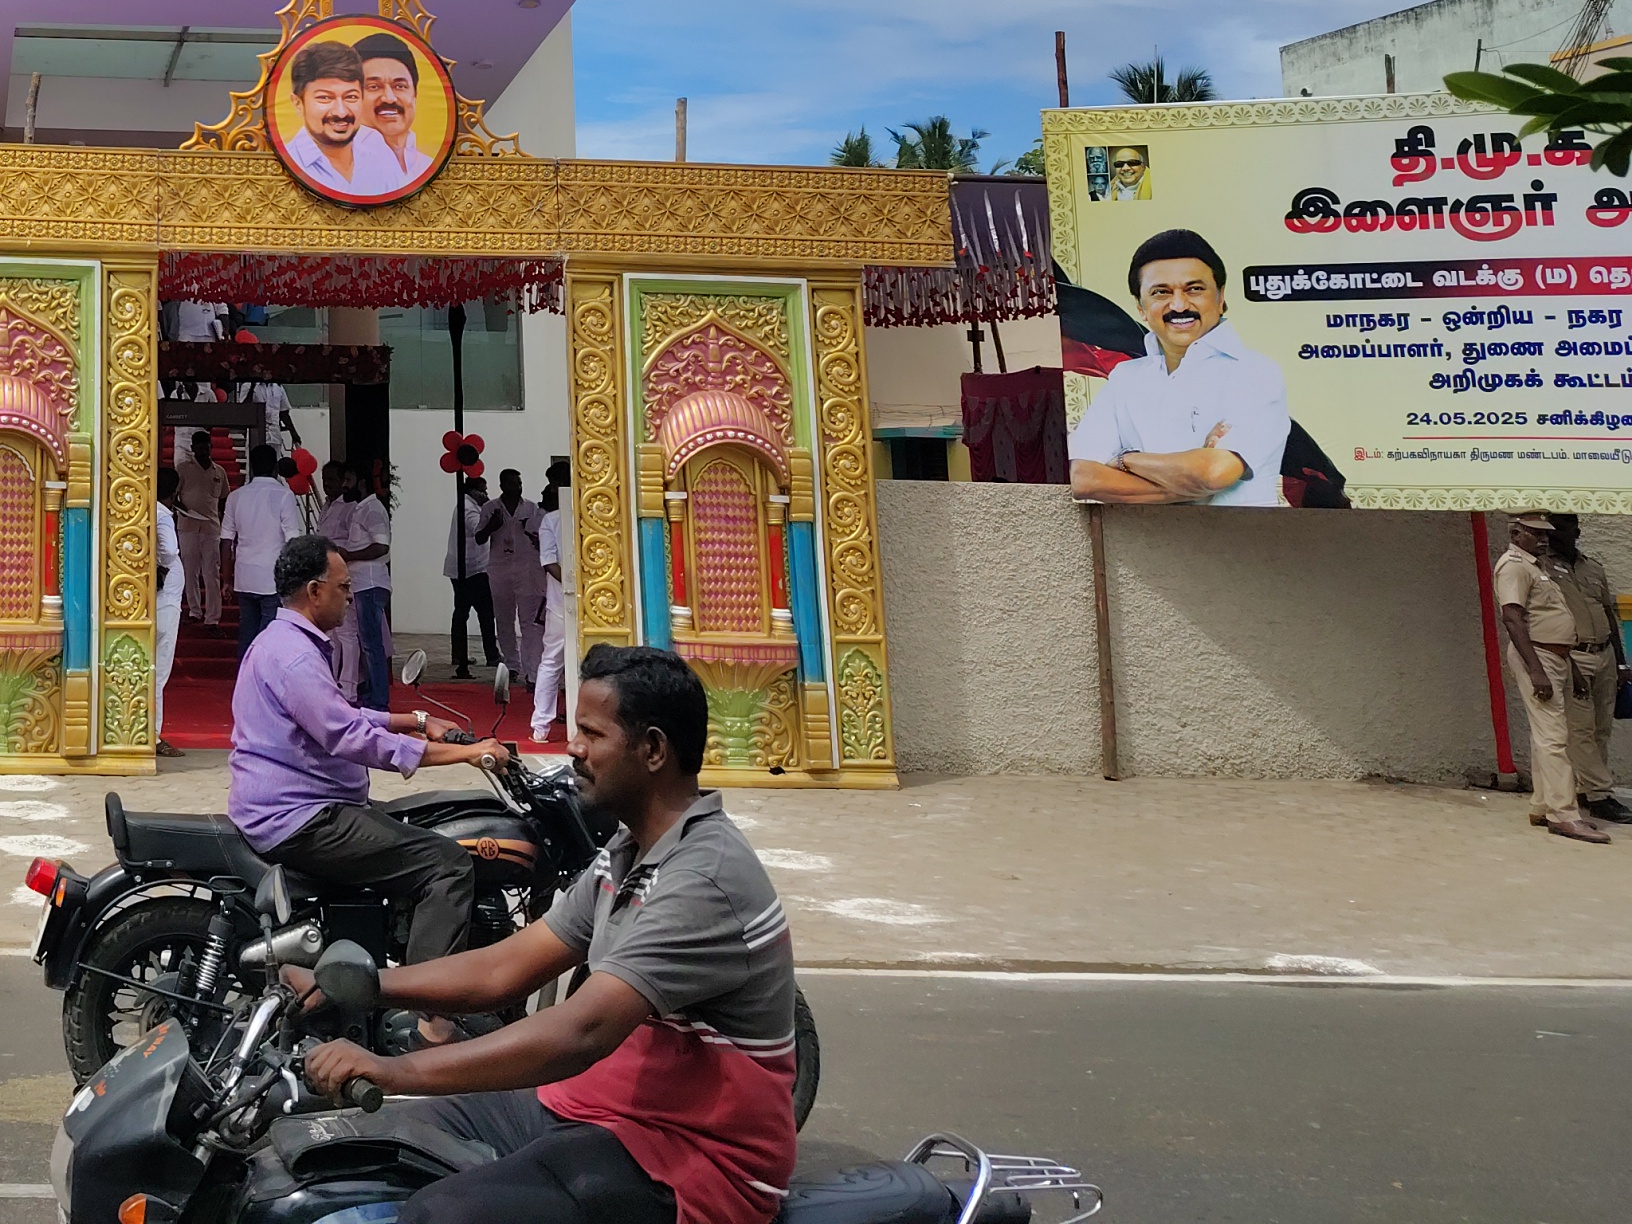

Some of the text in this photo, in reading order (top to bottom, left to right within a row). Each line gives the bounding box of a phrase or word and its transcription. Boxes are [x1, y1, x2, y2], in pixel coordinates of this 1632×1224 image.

[1390, 125, 1594, 187] தி.மு.க
[1284, 179, 1632, 242] இளைஞர் அ
[1250, 268, 1423, 299] புதுக்கோட்டை
[1432, 264, 1525, 290] வடக்கு
[1535, 264, 1578, 290] (ம)
[1325, 311, 1411, 333] மாநகர
[1442, 304, 1534, 332] ஒன்றிய
[1567, 309, 1623, 329] நகர
[1297, 338, 1452, 361] அமைப்பாளர்,
[1462, 340, 1544, 365] துணை
[1428, 367, 1544, 394] அறிமுகக்
[1406, 411, 1528, 426] 24.05.2025
